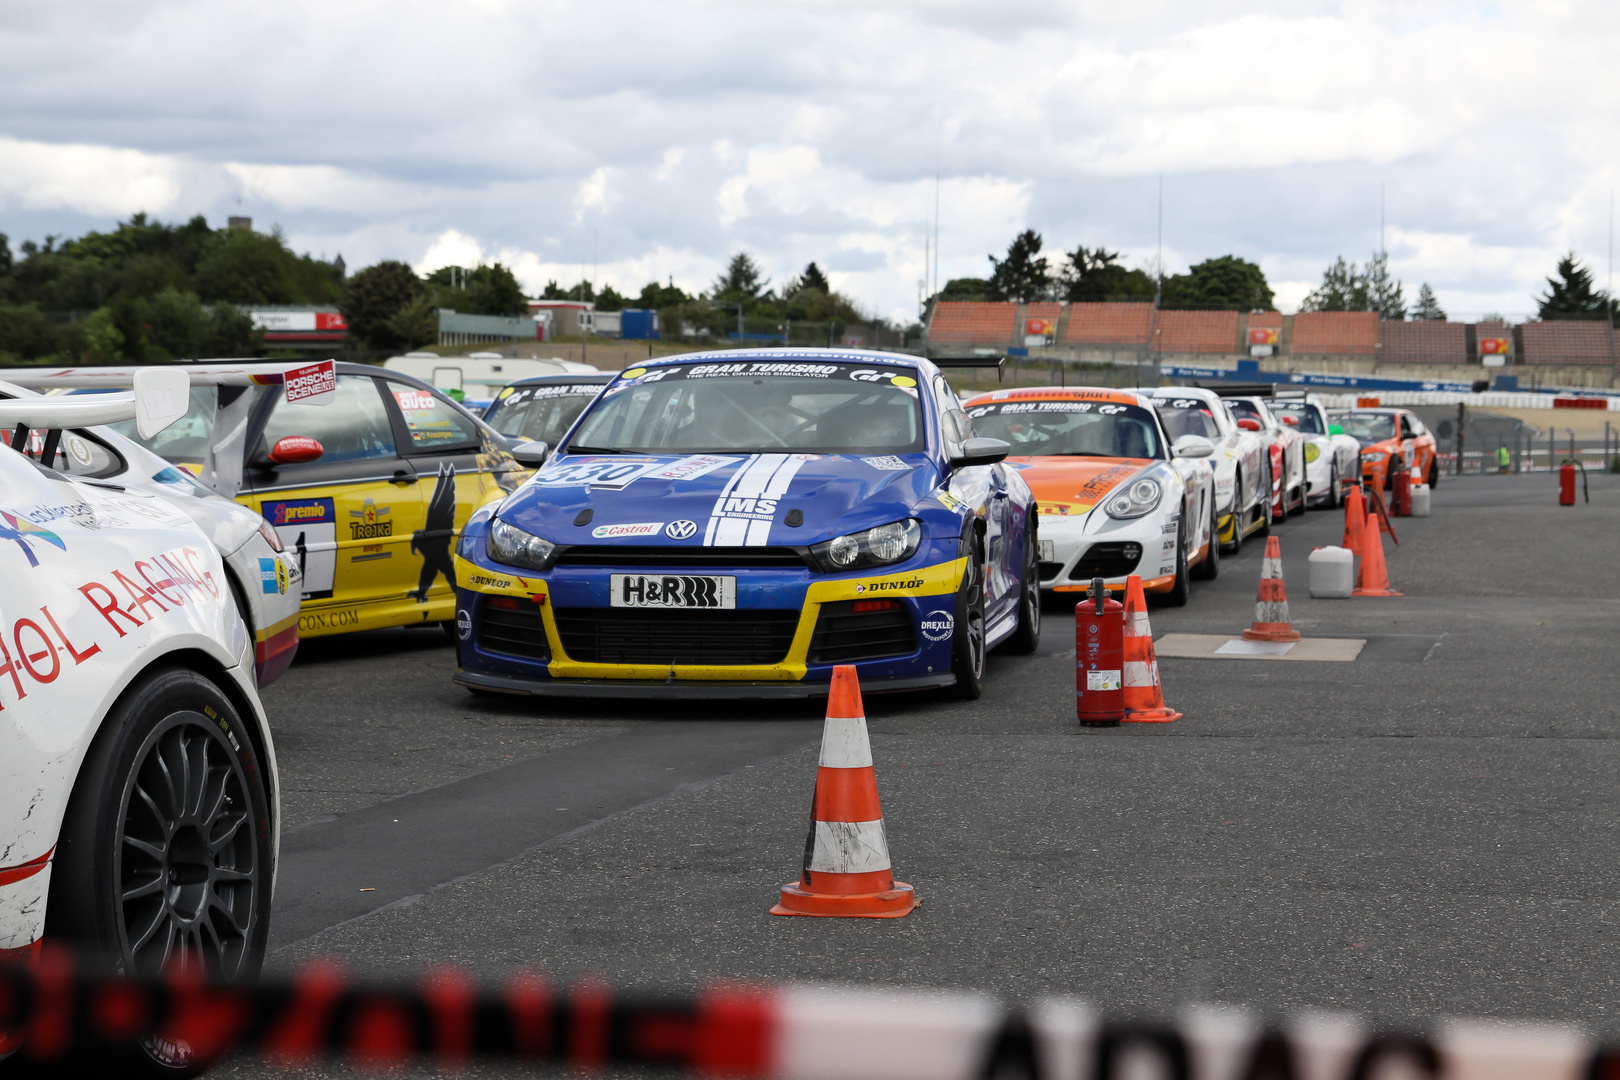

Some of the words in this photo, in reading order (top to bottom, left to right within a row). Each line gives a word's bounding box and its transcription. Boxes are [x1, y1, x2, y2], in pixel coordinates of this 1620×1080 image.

[688, 363, 747, 375] GRAN
[750, 363, 839, 375] TURISMO
[286, 370, 334, 391] PORSCHE
[287, 383, 322, 401] SCENE
[534, 385, 570, 397] GRAN
[570, 384, 606, 394] TURIS
[400, 396, 436, 410] auto
[1000, 403, 1037, 413] GRAN
[1038, 402, 1092, 411] TURISMO
[285, 502, 325, 522] premio
[711, 497, 778, 517] LMS
[726, 511, 774, 521] ENGINEERING
[608, 525, 654, 535] Castrol
[475, 575, 511, 589] DUNLOP
[868, 579, 925, 592] DUNLOP
[77, 547, 220, 638] RACING
